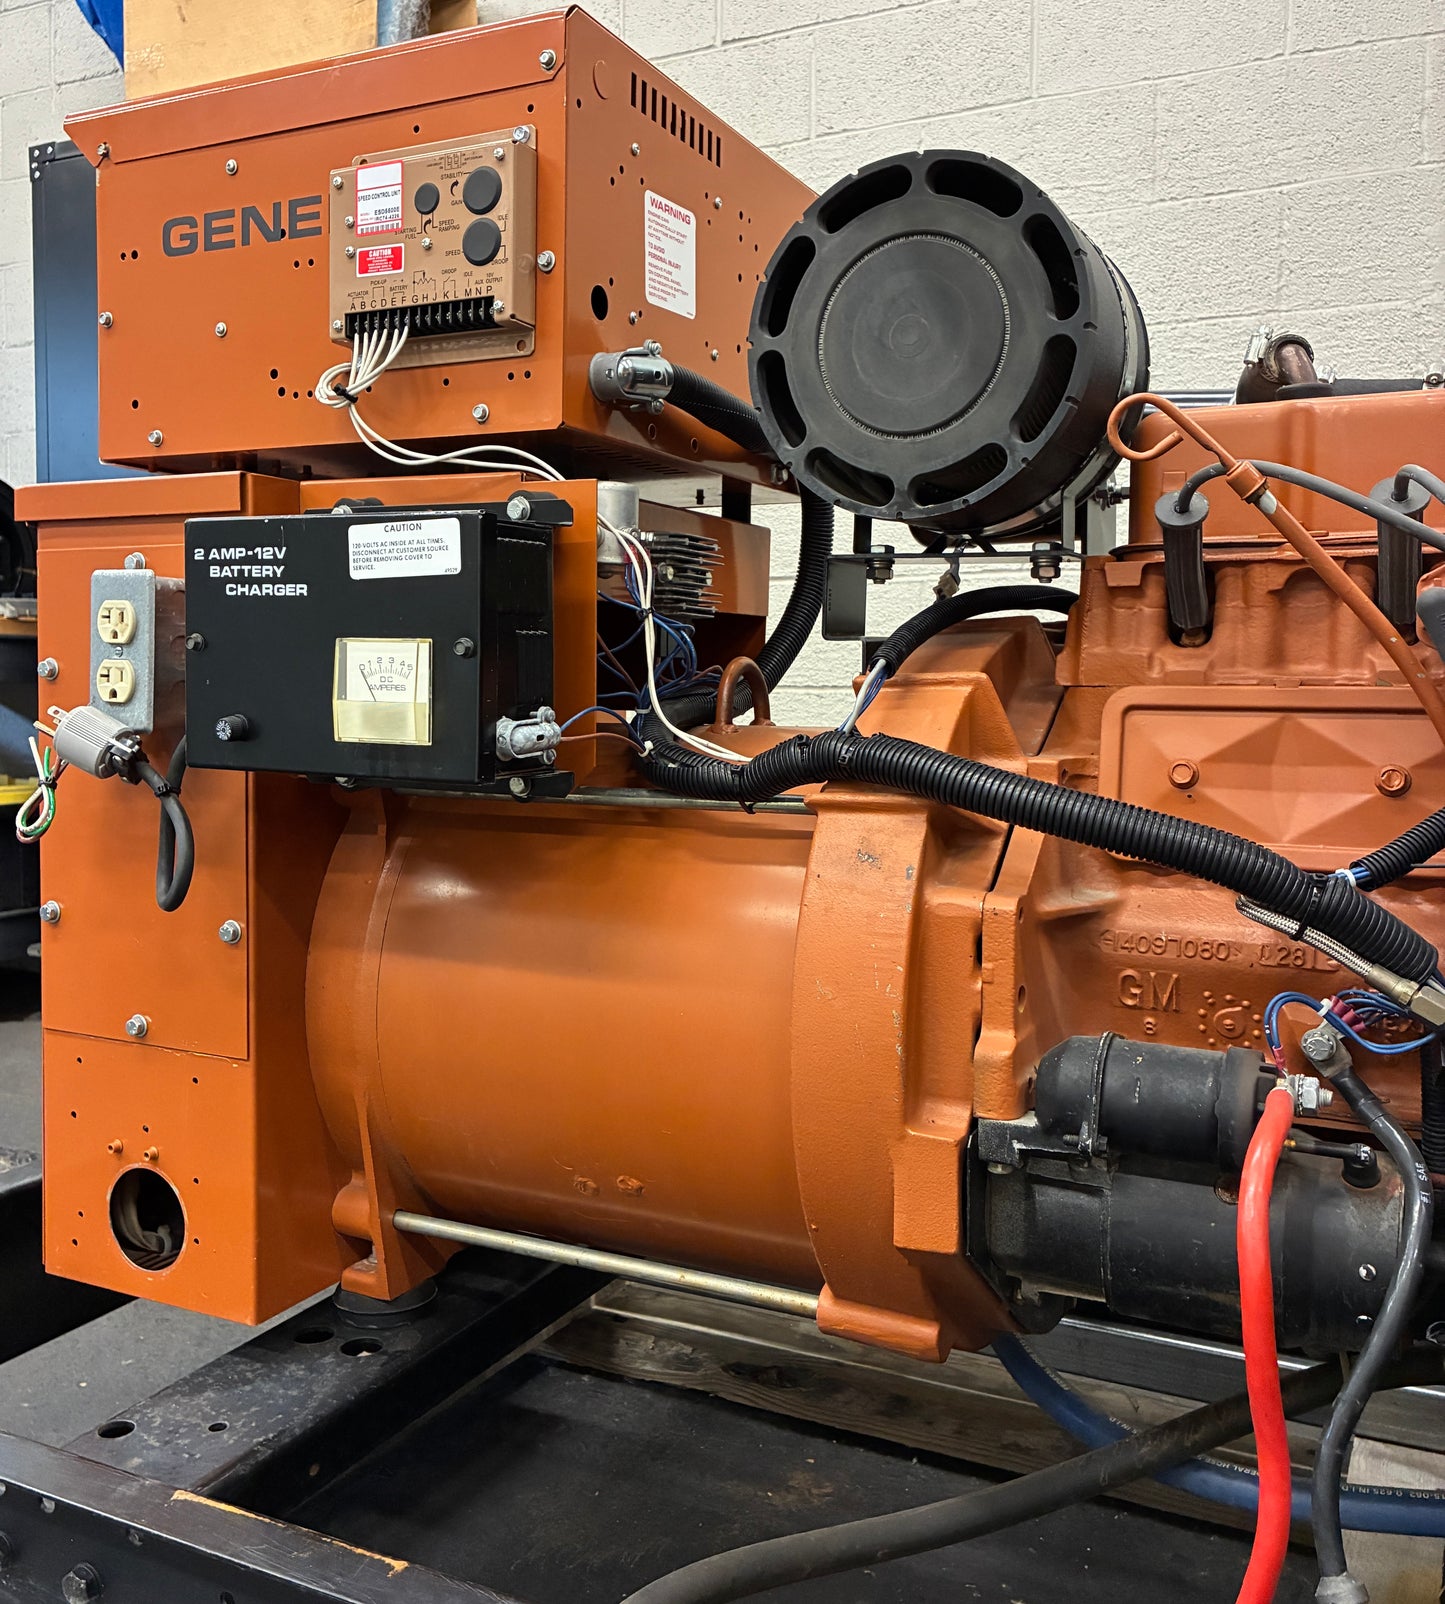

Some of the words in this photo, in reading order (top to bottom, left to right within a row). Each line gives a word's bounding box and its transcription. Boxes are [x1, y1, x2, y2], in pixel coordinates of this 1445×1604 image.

[441, 171, 463, 180] STABILITY
[650, 195, 691, 225] WARNING
[162, 195, 330, 257] GENE
[395, 227, 416, 235] STARTING
[438, 224, 460, 232] RAMPING
[369, 248, 392, 257] CAUTION
[648, 251, 667, 265] PERSONAL
[347, 290, 369, 298] ACTUATOR
[350, 302, 356, 311] A
[360, 301, 366, 310] B
[370, 299, 377, 308] C
[380, 298, 387, 308] D
[391, 297, 396, 306] E
[401, 296, 407, 305] F
[411, 294, 419, 304] G
[422, 293, 428, 302] H
[432, 292, 437, 301] J
[443, 290, 449, 299] K
[453, 290, 458, 299] L
[464, 288, 472, 297] M
[475, 287, 482, 296] N
[486, 285, 493, 294] P
[384, 523, 422, 533] CAUTION
[194, 548, 205, 560] 2
[208, 547, 287, 560] AMP-12V
[352, 549, 387, 557] DISCONNECT
[396, 546, 426, 554] CUSTOMER
[352, 556, 372, 564] BEFORE
[373, 555, 404, 563] REMOVING
[404, 553, 424, 561] COVER
[209, 565, 285, 578] BATTERY
[225, 583, 308, 597] CHARGER
[359, 663, 366, 671] 0
[376, 656, 383, 664] 2
[388, 656, 395, 664] 3
[368, 684, 406, 692] AMPERES
[1118, 968, 1180, 1013] GM
[1415, 1162, 1427, 1181] SAE
[1232, 1464, 1260, 1476] ERAL
[1358, 1486, 1370, 1494] IN
